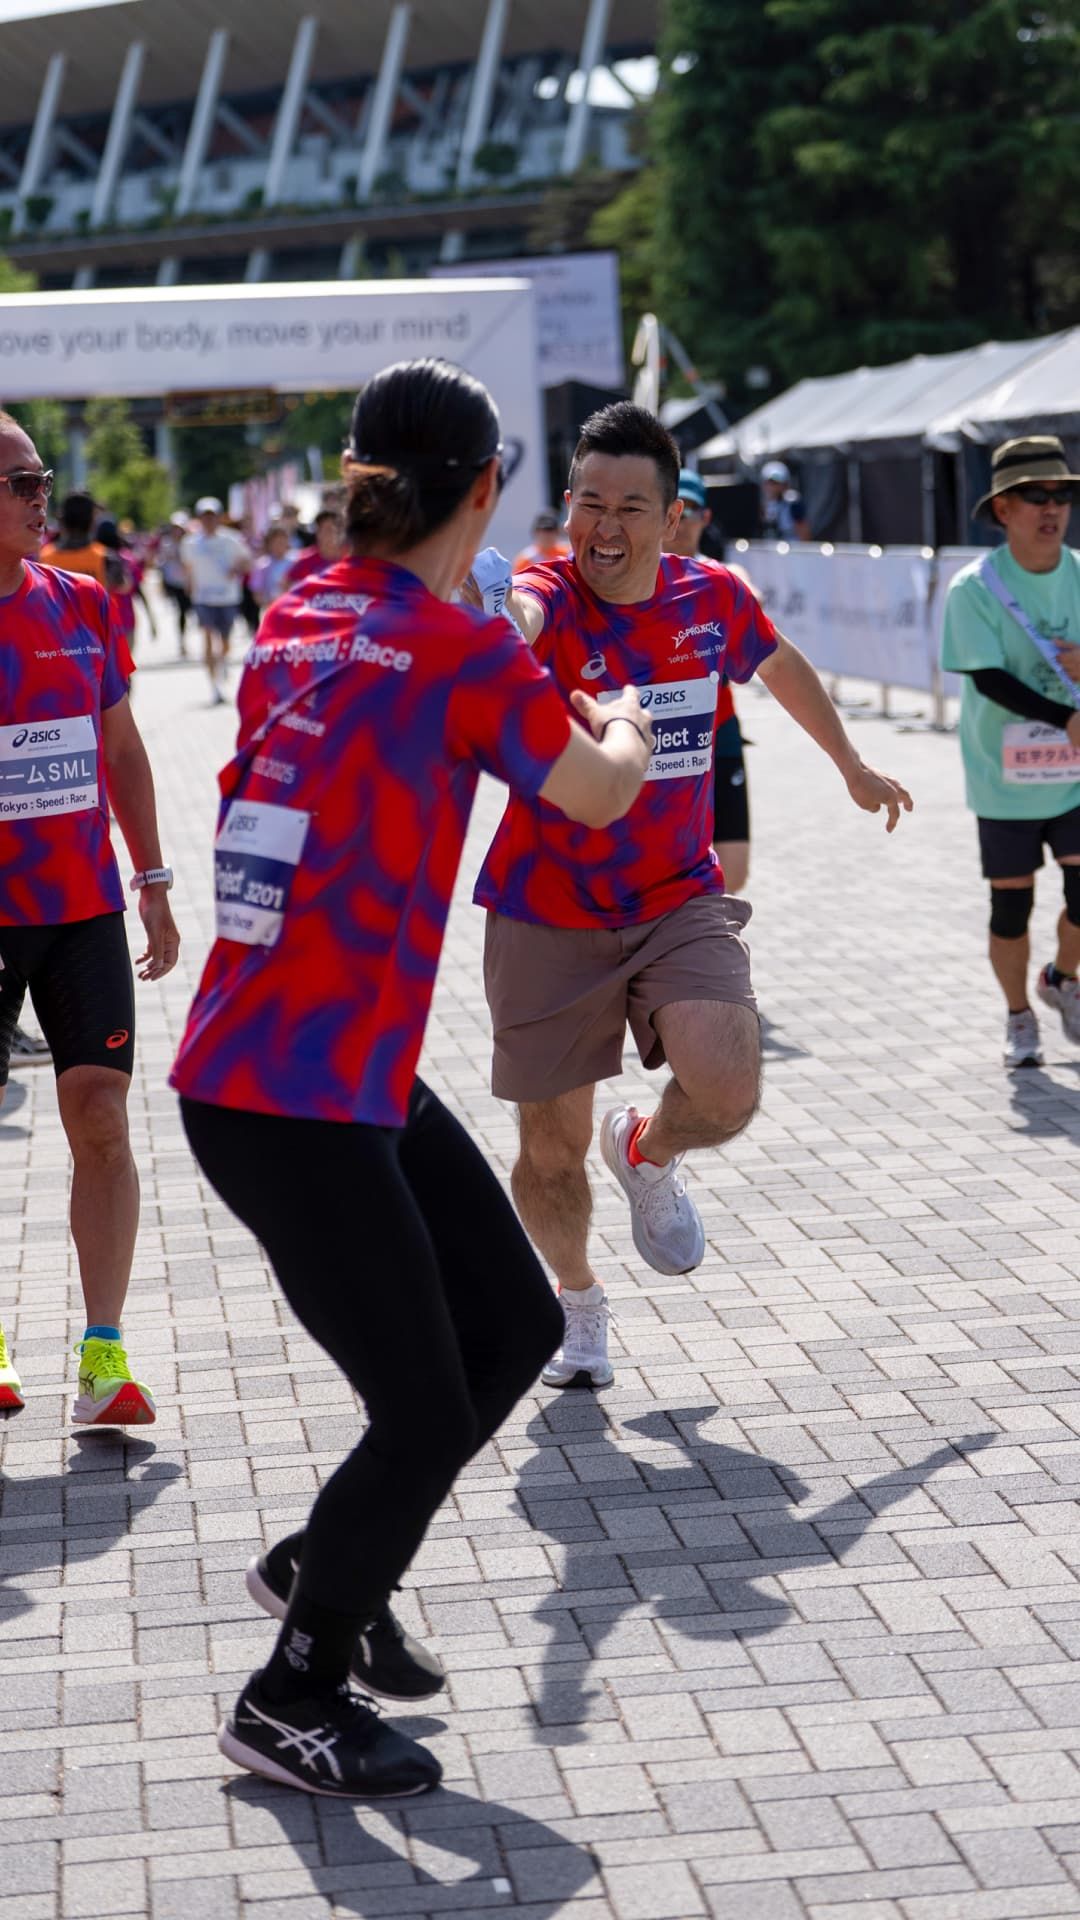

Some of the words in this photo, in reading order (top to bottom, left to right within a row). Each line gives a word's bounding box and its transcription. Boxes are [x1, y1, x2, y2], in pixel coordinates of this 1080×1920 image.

[57, 325, 128, 363] your
[228, 322, 312, 347] move
[317, 317, 385, 353] your
[392, 308, 470, 342] mind
[35, 649, 57, 660] Tokyo
[284, 636, 340, 668] Speed
[350, 634, 413, 672] Race
[654, 689, 686, 705] asics
[29, 728, 61, 744] asics
[655, 757, 685, 773] Speed
[36, 795, 65, 810] Speed
[70, 793, 87, 804] Race
[243, 881, 284, 909] 3201
